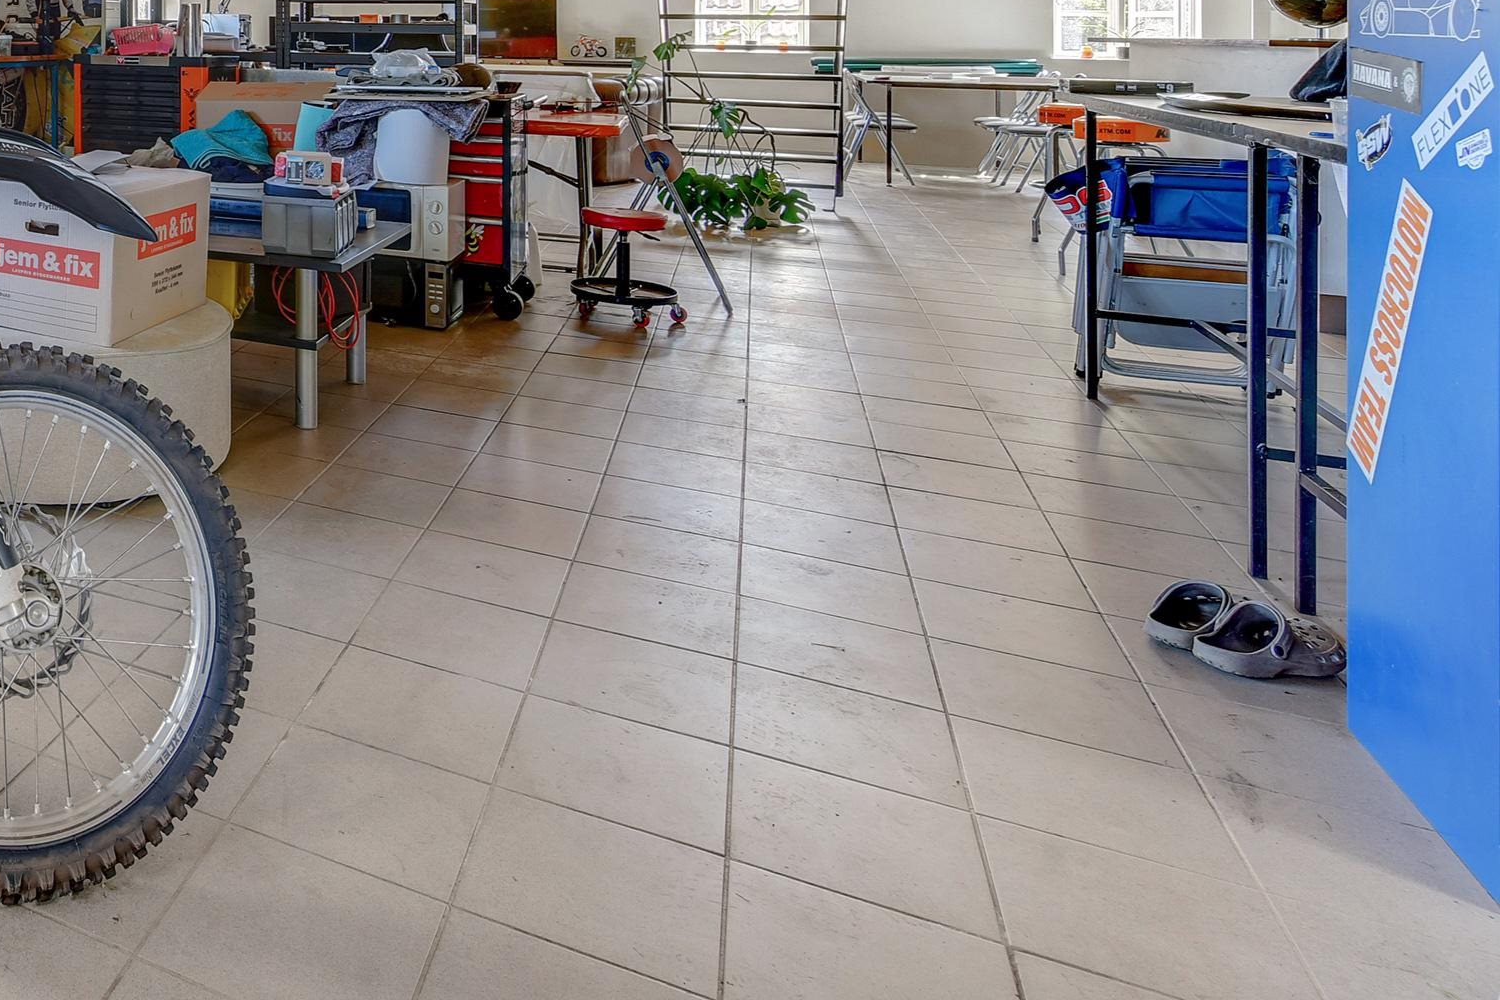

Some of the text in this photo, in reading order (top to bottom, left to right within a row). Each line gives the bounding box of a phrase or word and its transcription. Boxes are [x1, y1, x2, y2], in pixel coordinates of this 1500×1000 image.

[1352, 62, 1392, 90] HAVANA
[272, 127, 292, 142] fix
[13, 198, 37, 208] Senior
[168, 216, 179, 239] &
[180, 212, 195, 235] fix
[42, 251, 60, 272] &
[64, 254, 94, 278] fix
[1350, 187, 1429, 463] MOTOCROSS TEAM
[156, 726, 185, 765] EXCEL
